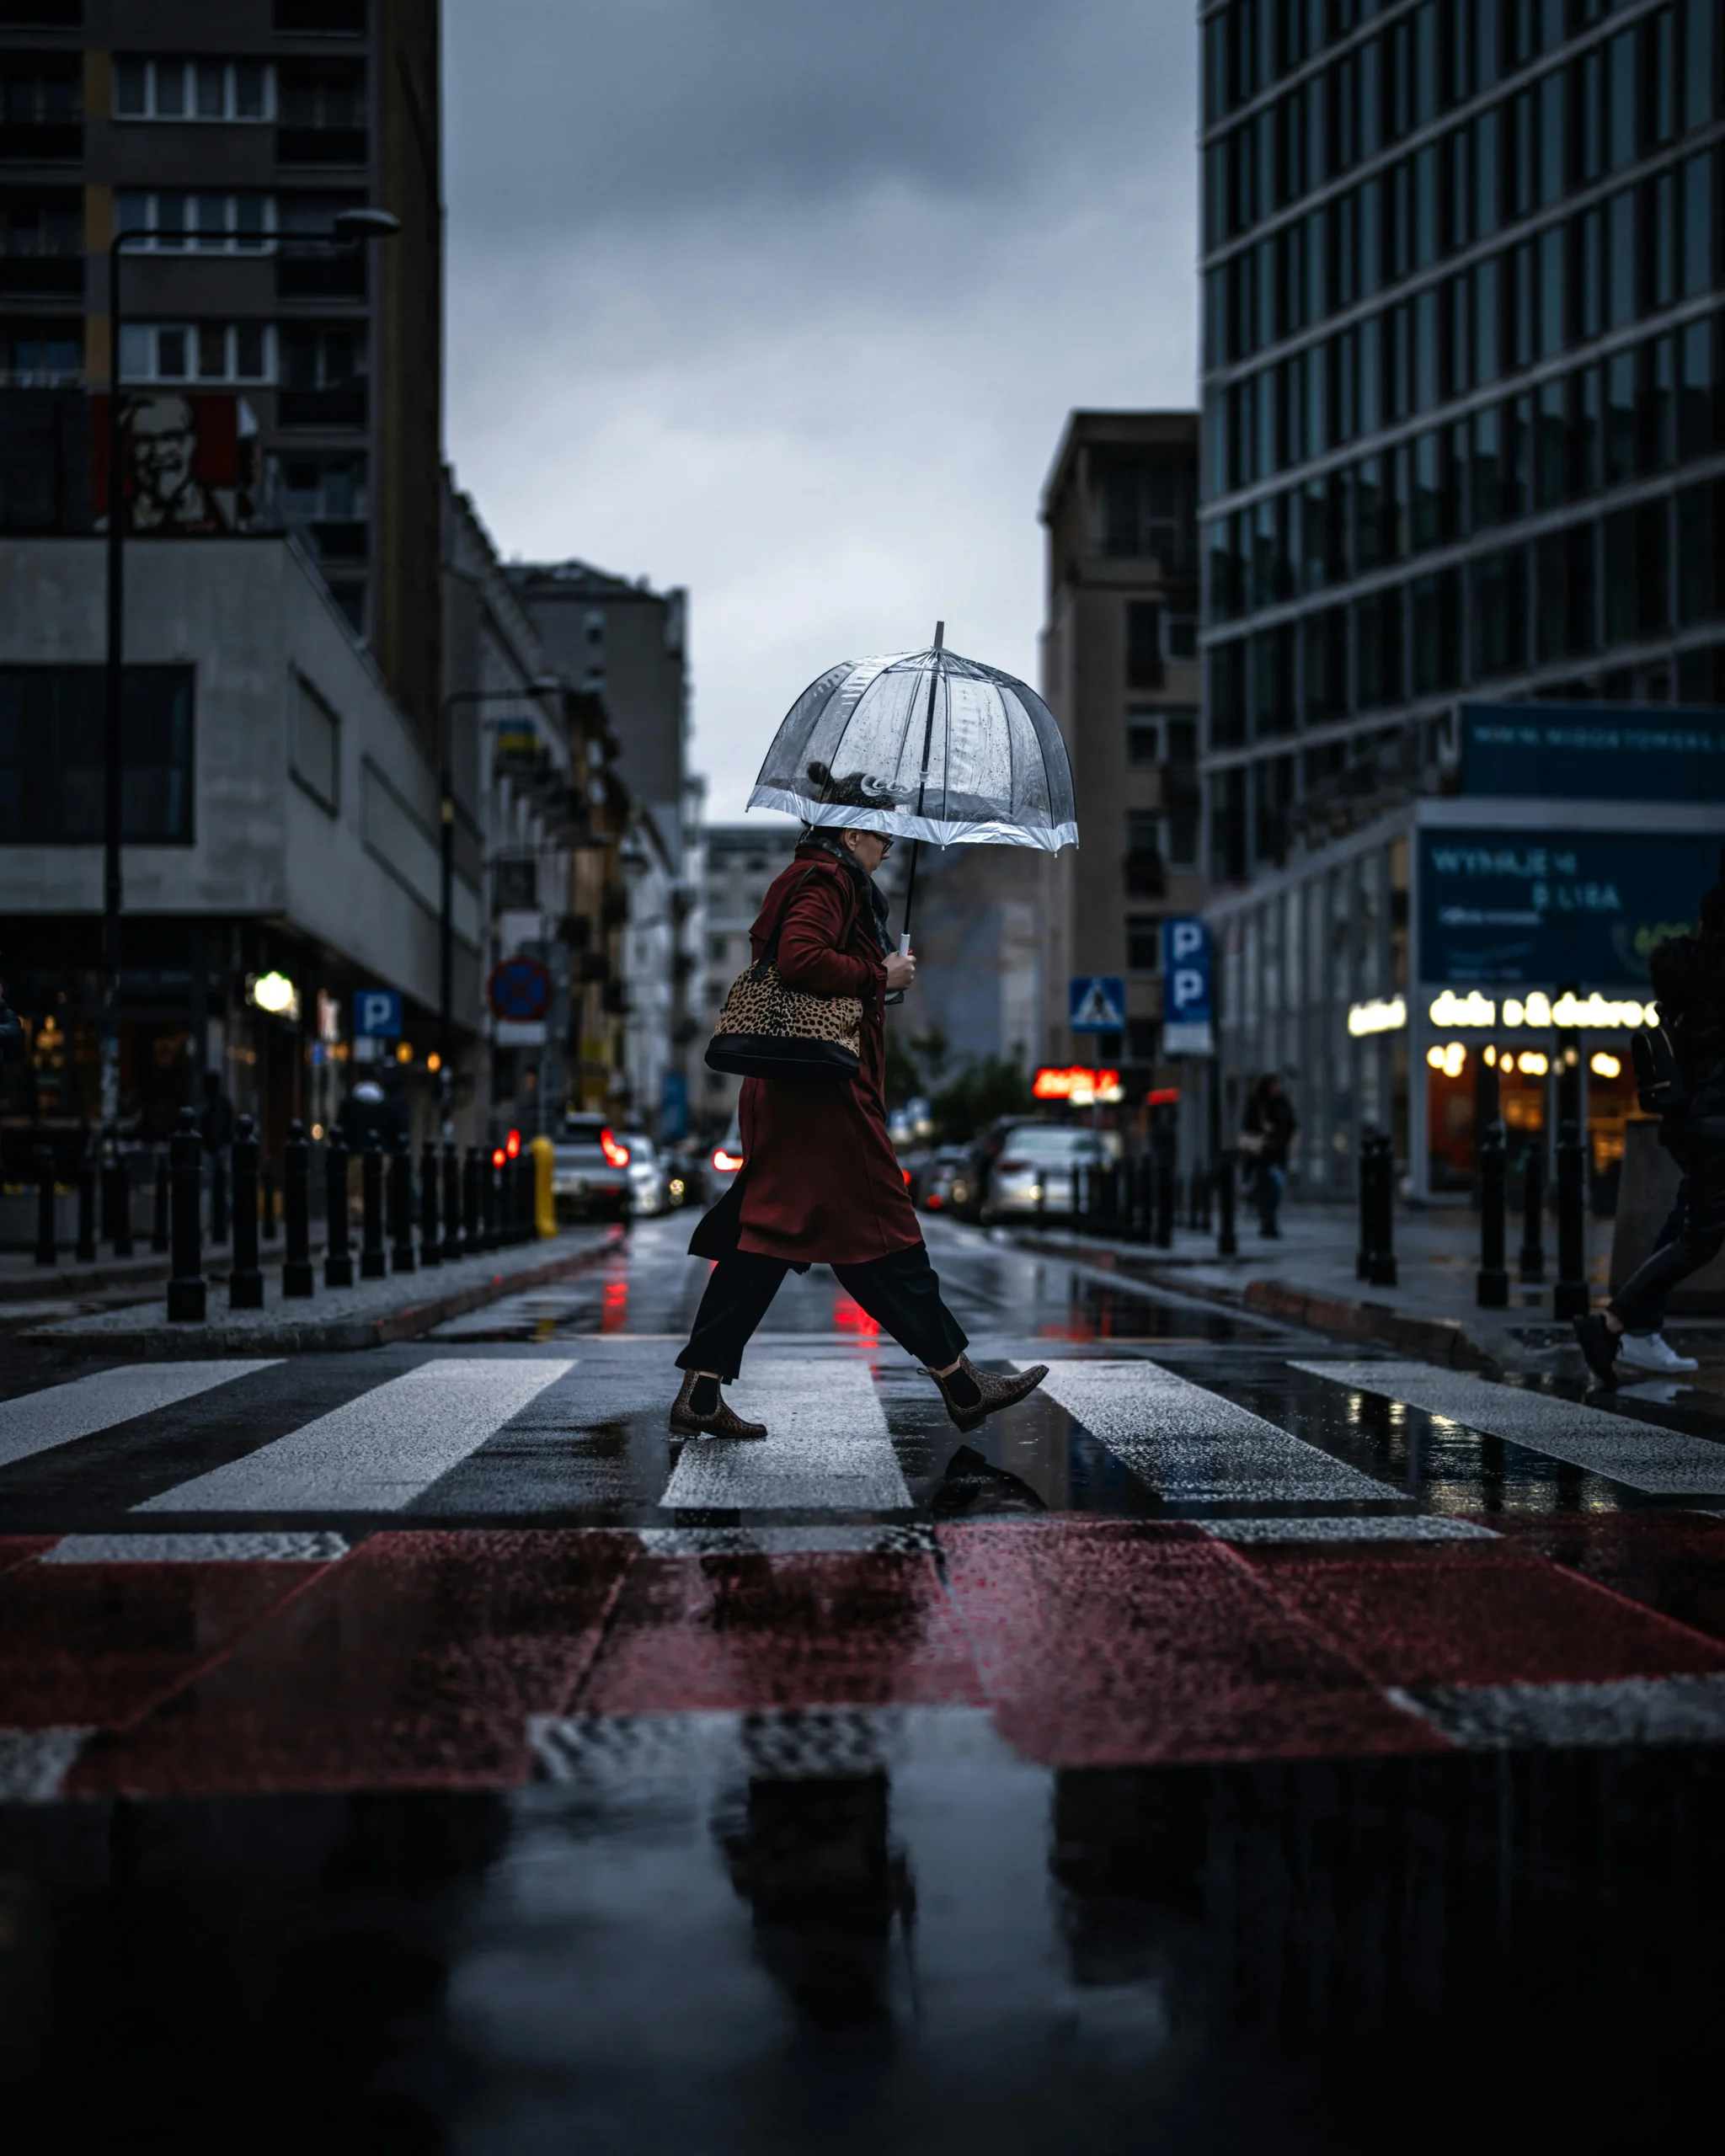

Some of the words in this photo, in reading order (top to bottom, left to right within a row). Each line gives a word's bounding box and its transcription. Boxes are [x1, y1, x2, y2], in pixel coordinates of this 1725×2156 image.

[1172, 921, 1204, 963] P
[1172, 969, 1204, 1010] P
[364, 994, 392, 1034] P
